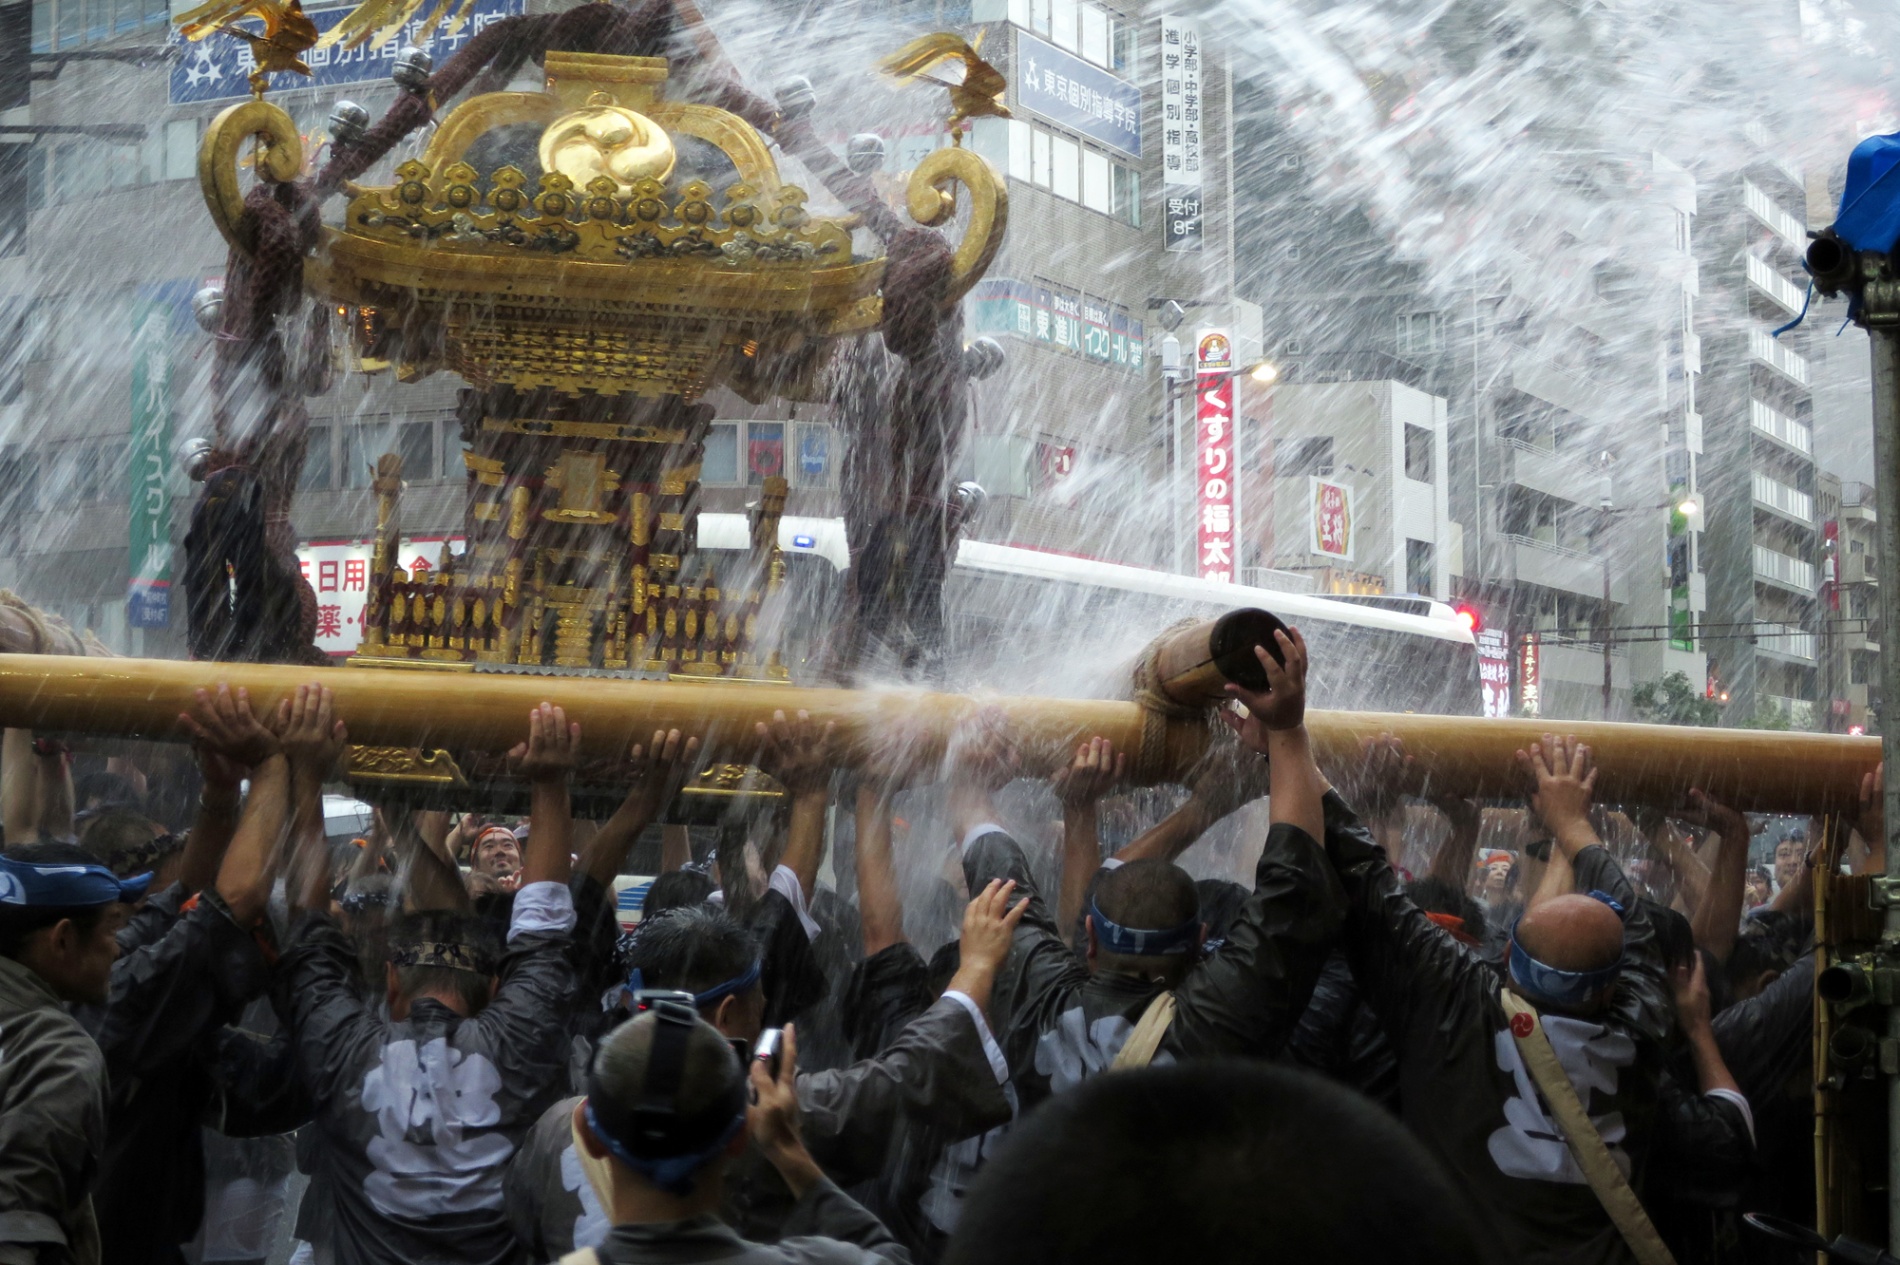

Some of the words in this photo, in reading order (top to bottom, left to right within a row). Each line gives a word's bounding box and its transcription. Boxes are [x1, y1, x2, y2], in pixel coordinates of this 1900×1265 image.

[1043, 68, 1137, 135] 東京個別指導学院
[1164, 28, 1182, 171] 進学個別指導
[1168, 199, 1199, 216] 受付
[1173, 220, 1195, 235] 8F
[1036, 309, 1128, 364] 東進ハイスクール
